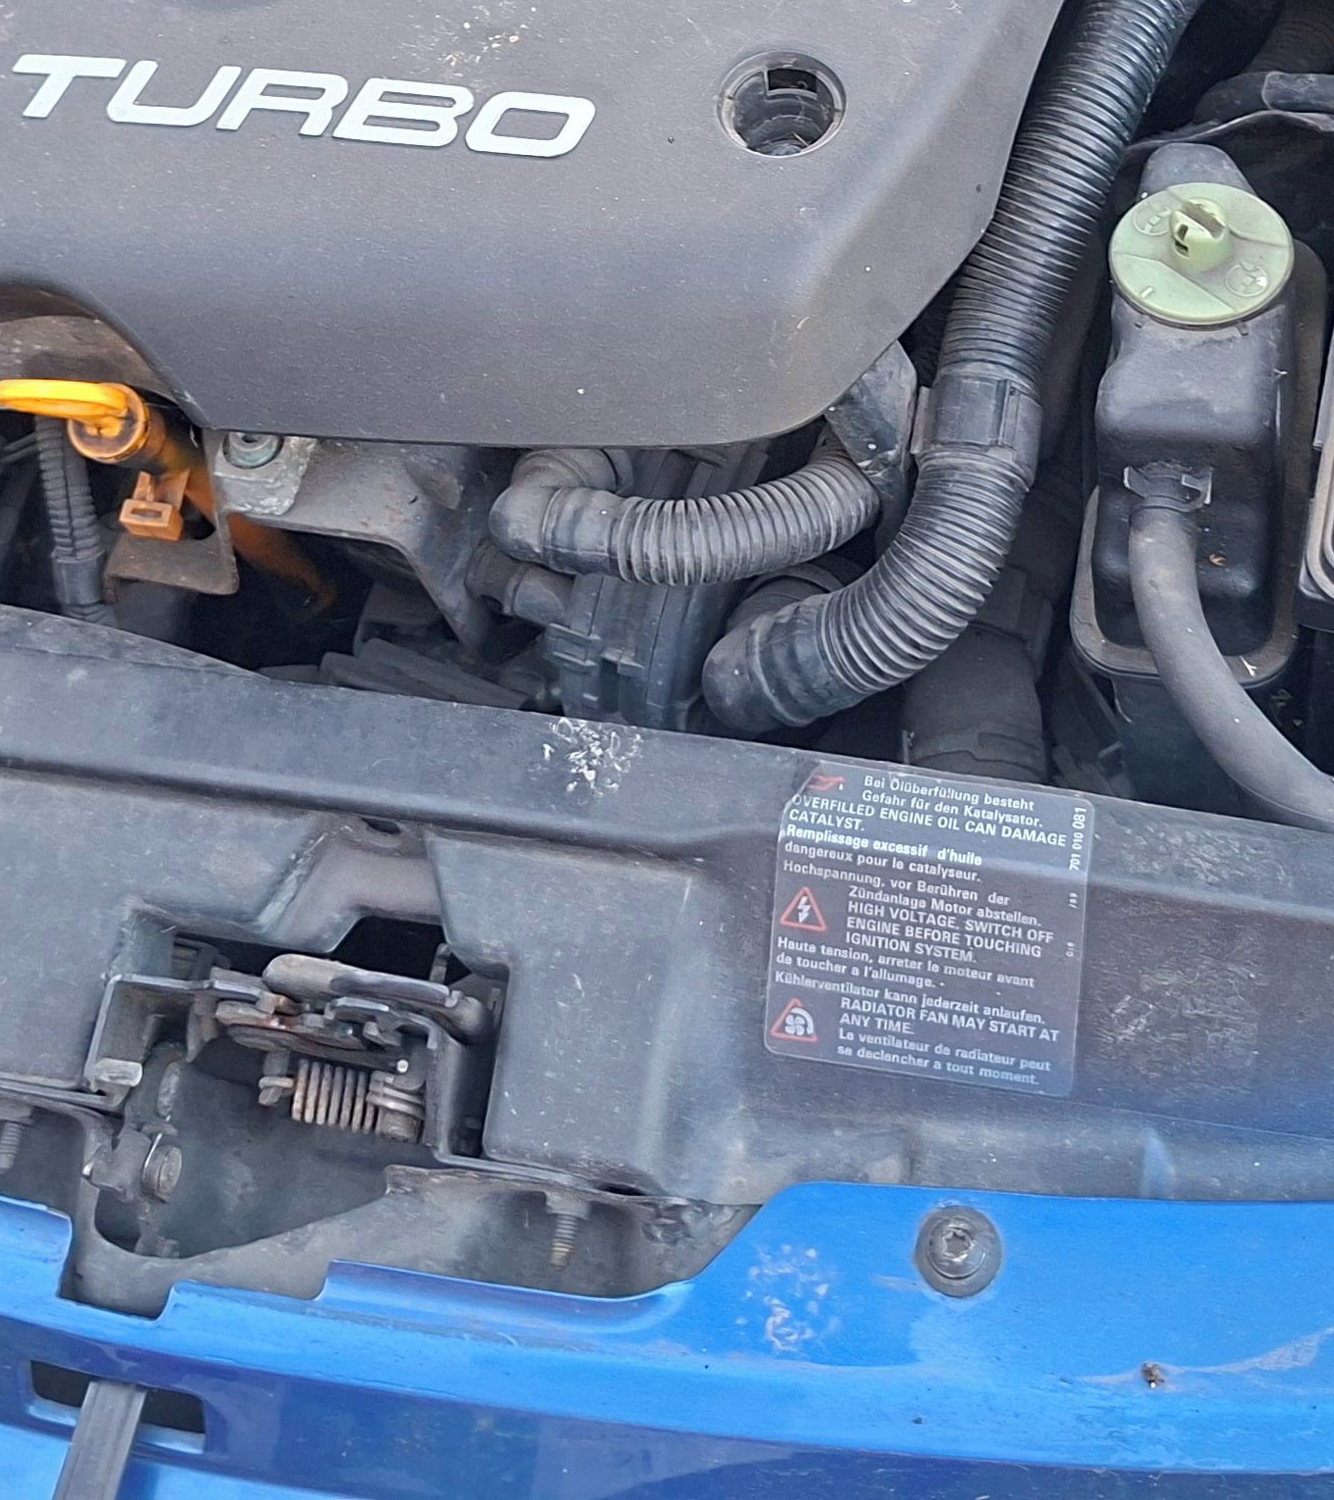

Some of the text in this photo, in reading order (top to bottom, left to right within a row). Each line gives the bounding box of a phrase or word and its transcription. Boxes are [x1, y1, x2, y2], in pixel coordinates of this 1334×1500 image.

[13, 54, 596, 157] TURBO
[861, 789, 1043, 828] Gefahr für den Katalysator.
[864, 775, 885, 788] Bei
[983, 793, 1034, 811] besteht
[789, 809, 865, 831] CATALYST.
[791, 794, 1067, 846] OVERFILLED ENGINE OIL CAN DAMAGE
[1069, 807, 1087, 871] 701 010 081
[783, 841, 982, 883] dangereux pour le catalyseur.
[785, 824, 982, 865] Remplissage excessif d'huile
[847, 886, 1042, 926] Zündanlage Motor abstellen.
[890, 878, 911, 890] vor
[916, 880, 978, 900] Berühren
[987, 891, 1009, 905] der
[845, 932, 910, 952] IGNITION
[846, 917, 1042, 957] ENGINE BEFORE TOUCHING
[847, 901, 884, 917] HIGH
[964, 919, 1022, 938] SWITCH
[1026, 929, 1054, 943] OFF
[776, 953, 792, 965] de
[796, 956, 846, 974] toucher
[777, 937, 816, 954] Haute
[927, 961, 939, 973] le
[943, 964, 992, 981] moteur
[996, 972, 1036, 988] avant
[774, 971, 1046, 1023] Kühlerventilator kann jederzeit anlaufen.
[839, 1012, 870, 1027] ANY
[840, 998, 1059, 1042] RADIATOR FAN MAY START AT
[837, 1046, 852, 1056] se
[946, 1061, 974, 1074] tout
[838, 1028, 1051, 1073] Le ventilateur de radiateur peut
